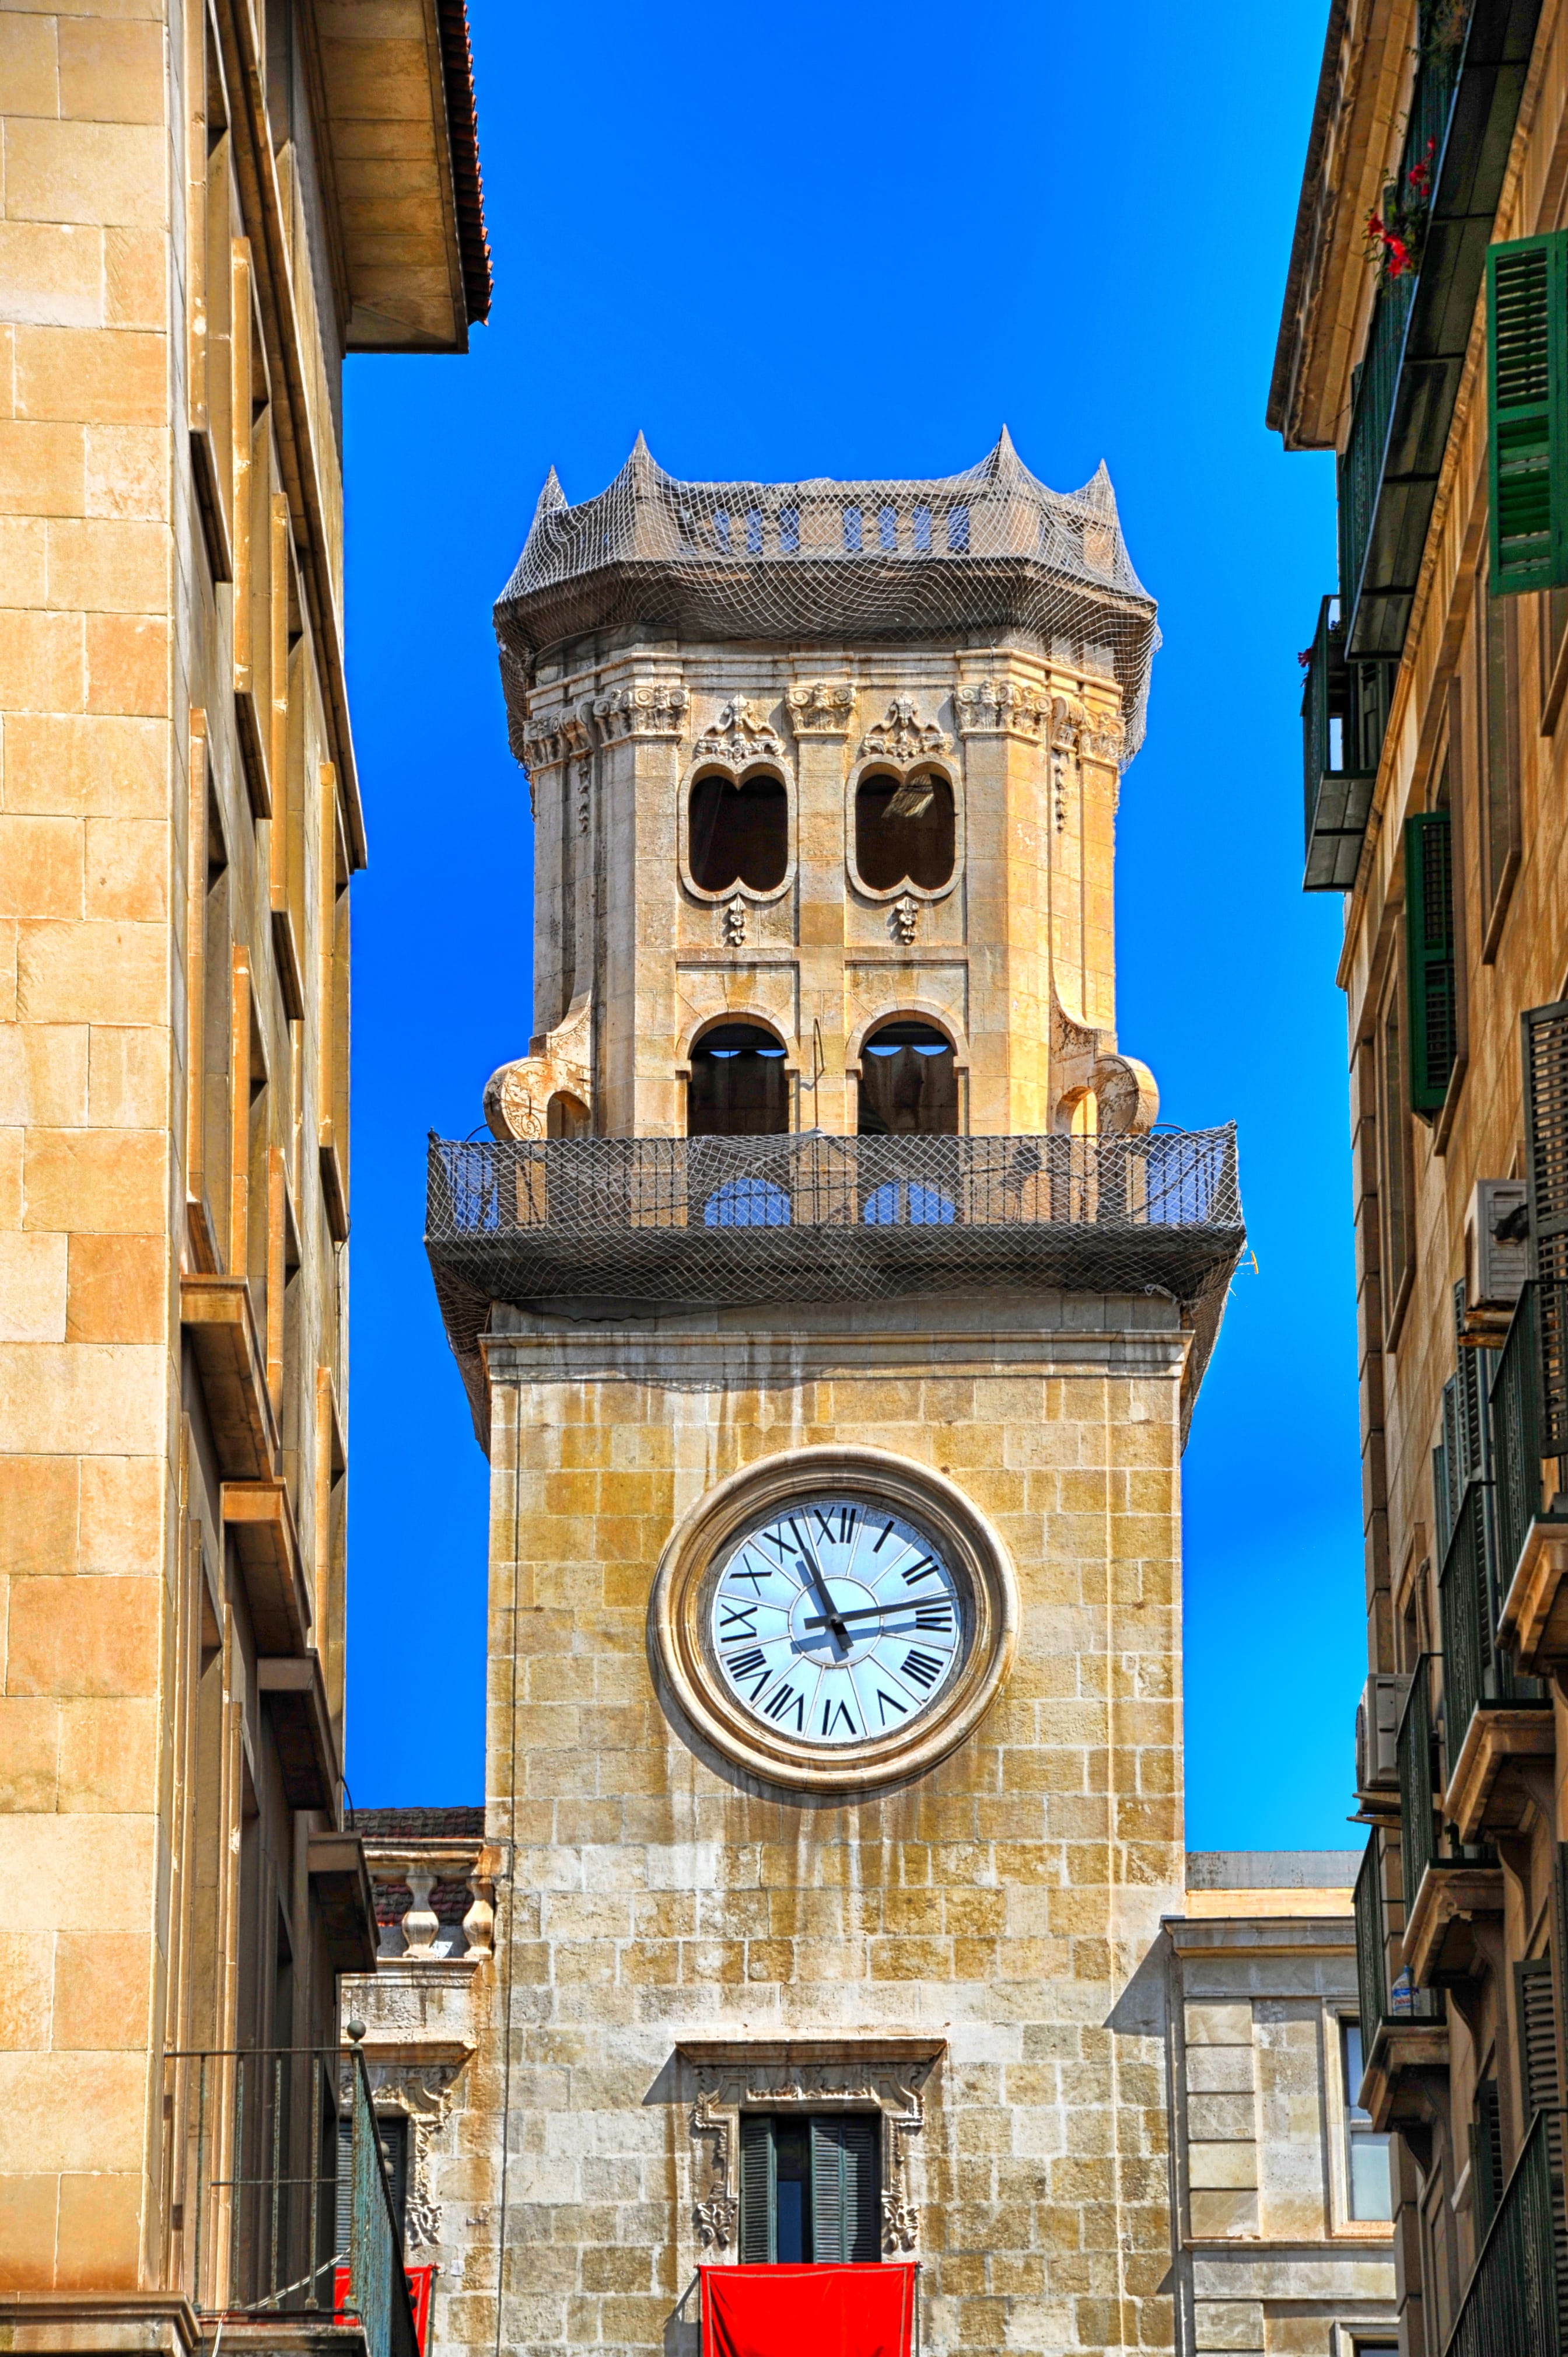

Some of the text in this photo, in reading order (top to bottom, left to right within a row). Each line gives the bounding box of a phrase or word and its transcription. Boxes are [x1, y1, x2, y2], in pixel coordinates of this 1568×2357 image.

[762, 1517, 805, 1564] XI
[814, 1506, 856, 1547] XII
[872, 1520, 895, 1553] I
[729, 1553, 773, 1597] X
[901, 1555, 940, 1586] II
[720, 1604, 758, 1643] IX
[915, 1606, 953, 1632] III
[726, 1649, 774, 1702] VIII
[900, 1649, 944, 1690] IIII
[763, 1684, 804, 1732] VII
[821, 1699, 857, 1736] VI
[877, 1689, 908, 1726] V
